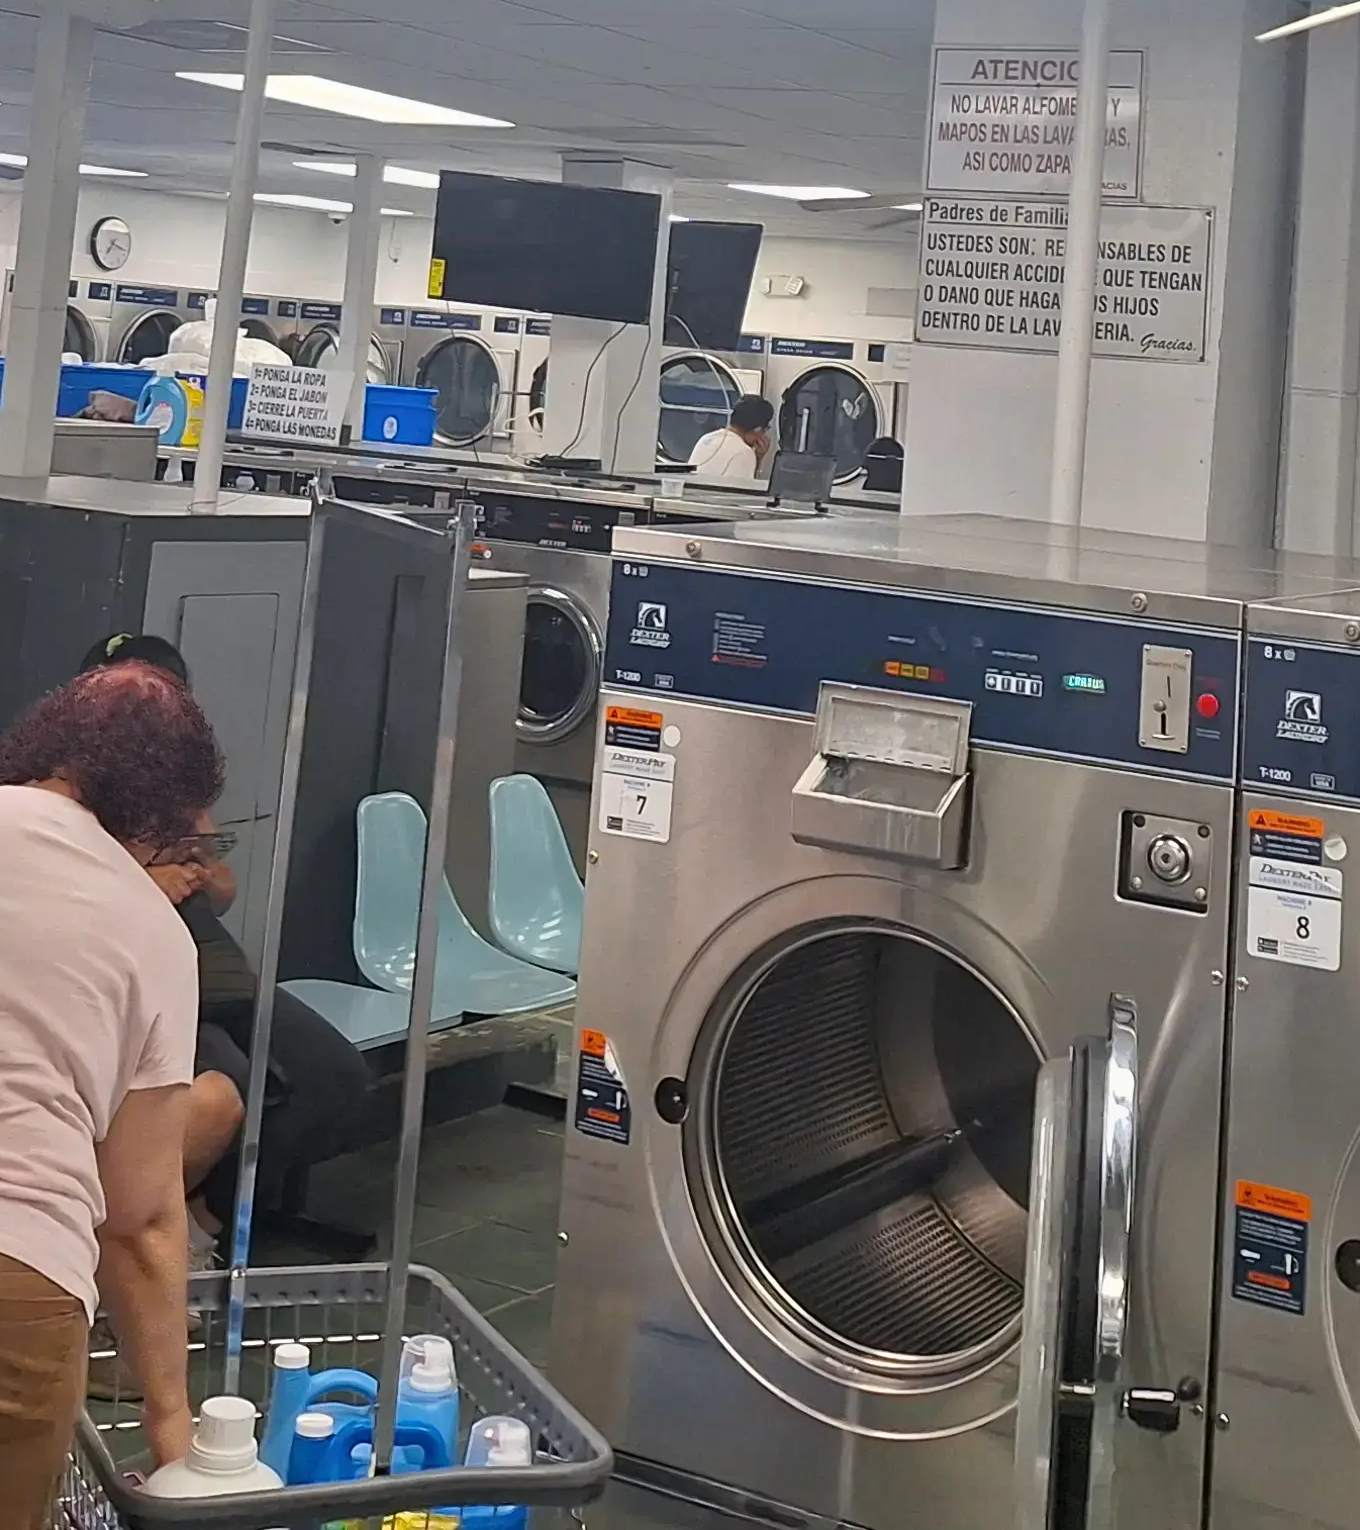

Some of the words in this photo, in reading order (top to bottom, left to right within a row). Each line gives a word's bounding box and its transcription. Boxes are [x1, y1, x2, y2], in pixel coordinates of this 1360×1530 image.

[971, 59, 1079, 81] ATENCIO
[951, 94, 971, 114] NO
[975, 95, 1018, 115] LAVAR
[1112, 98, 1120, 117] Y
[939, 122, 986, 142] MAPOS
[991, 124, 1010, 143] EN
[1013, 125, 1040, 144] LAS
[962, 151, 985, 171] ASI
[990, 152, 1032, 173] COMO
[1101, 182, 1128, 191] ACIAS
[929, 203, 983, 221] Padres
[990, 205, 1008, 222] de
[927, 234, 993, 253] USTEDES
[1045, 239, 1165, 263] RENSABLES
[1172, 245, 1192, 263] DE
[926, 259, 1008, 280] CUALQUIER
[1104, 269, 1133, 288] QUE
[1140, 272, 1202, 291] TENGAN
[924, 284, 933, 301] O
[939, 286, 978, 305] DANO
[985, 289, 1013, 308] QUE
[1020, 290, 1060, 310] HAGA
[1114, 297, 1159, 316] HIJOS
[922, 311, 979, 332] DENTRO
[985, 315, 1004, 333] DE
[1010, 316, 1028, 335] LA
[263, 368, 289, 384] PONGA
[292, 370, 301, 384] LA
[303, 372, 326, 387] ROPA
[260, 385, 286, 400] PONGA
[288, 388, 297, 401] EL
[299, 389, 328, 404] JABON
[257, 401, 286, 417] CIERRE
[286, 405, 295, 418] LA
[297, 406, 328, 421] PUERTA
[254, 418, 281, 433] PONGA
[282, 421, 296, 435] LAS
[298, 423, 337, 440] MONEDAS
[630, 628, 670, 641] DEXTER
[1264, 646, 1273, 659] 8
[615, 669, 641, 682] T-1200
[1277, 720, 1329, 735] DEXTER
[1259, 767, 1291, 782] T-1200
[636, 795, 647, 815] 7
[1296, 916, 1310, 939] 8
